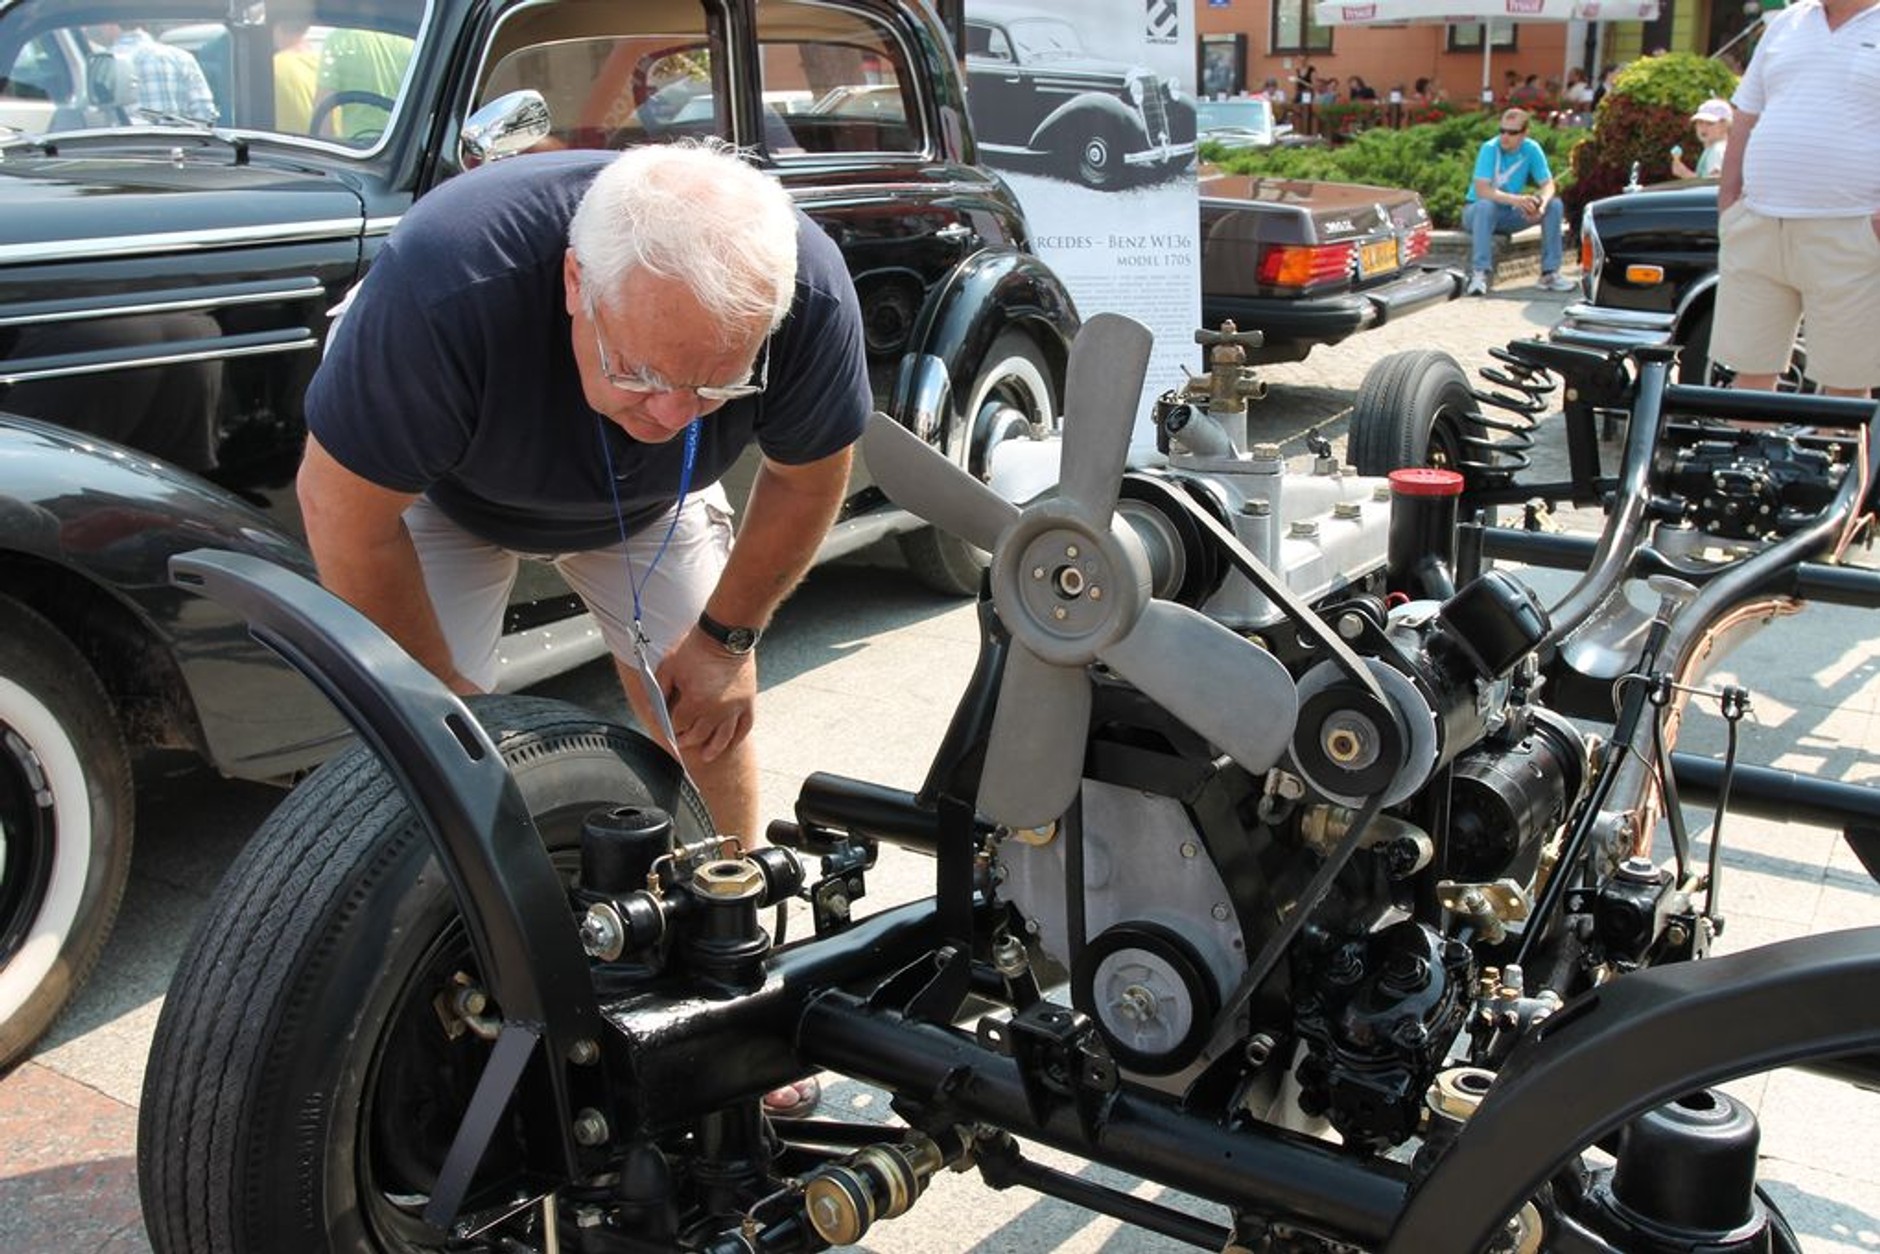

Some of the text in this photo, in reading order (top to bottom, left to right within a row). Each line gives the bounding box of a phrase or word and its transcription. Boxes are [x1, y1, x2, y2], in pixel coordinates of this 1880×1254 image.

[1034, 235, 1092, 248] RCEDES
[1150, 233, 1192, 248] W136
[1117, 256, 1160, 267] MODEL
